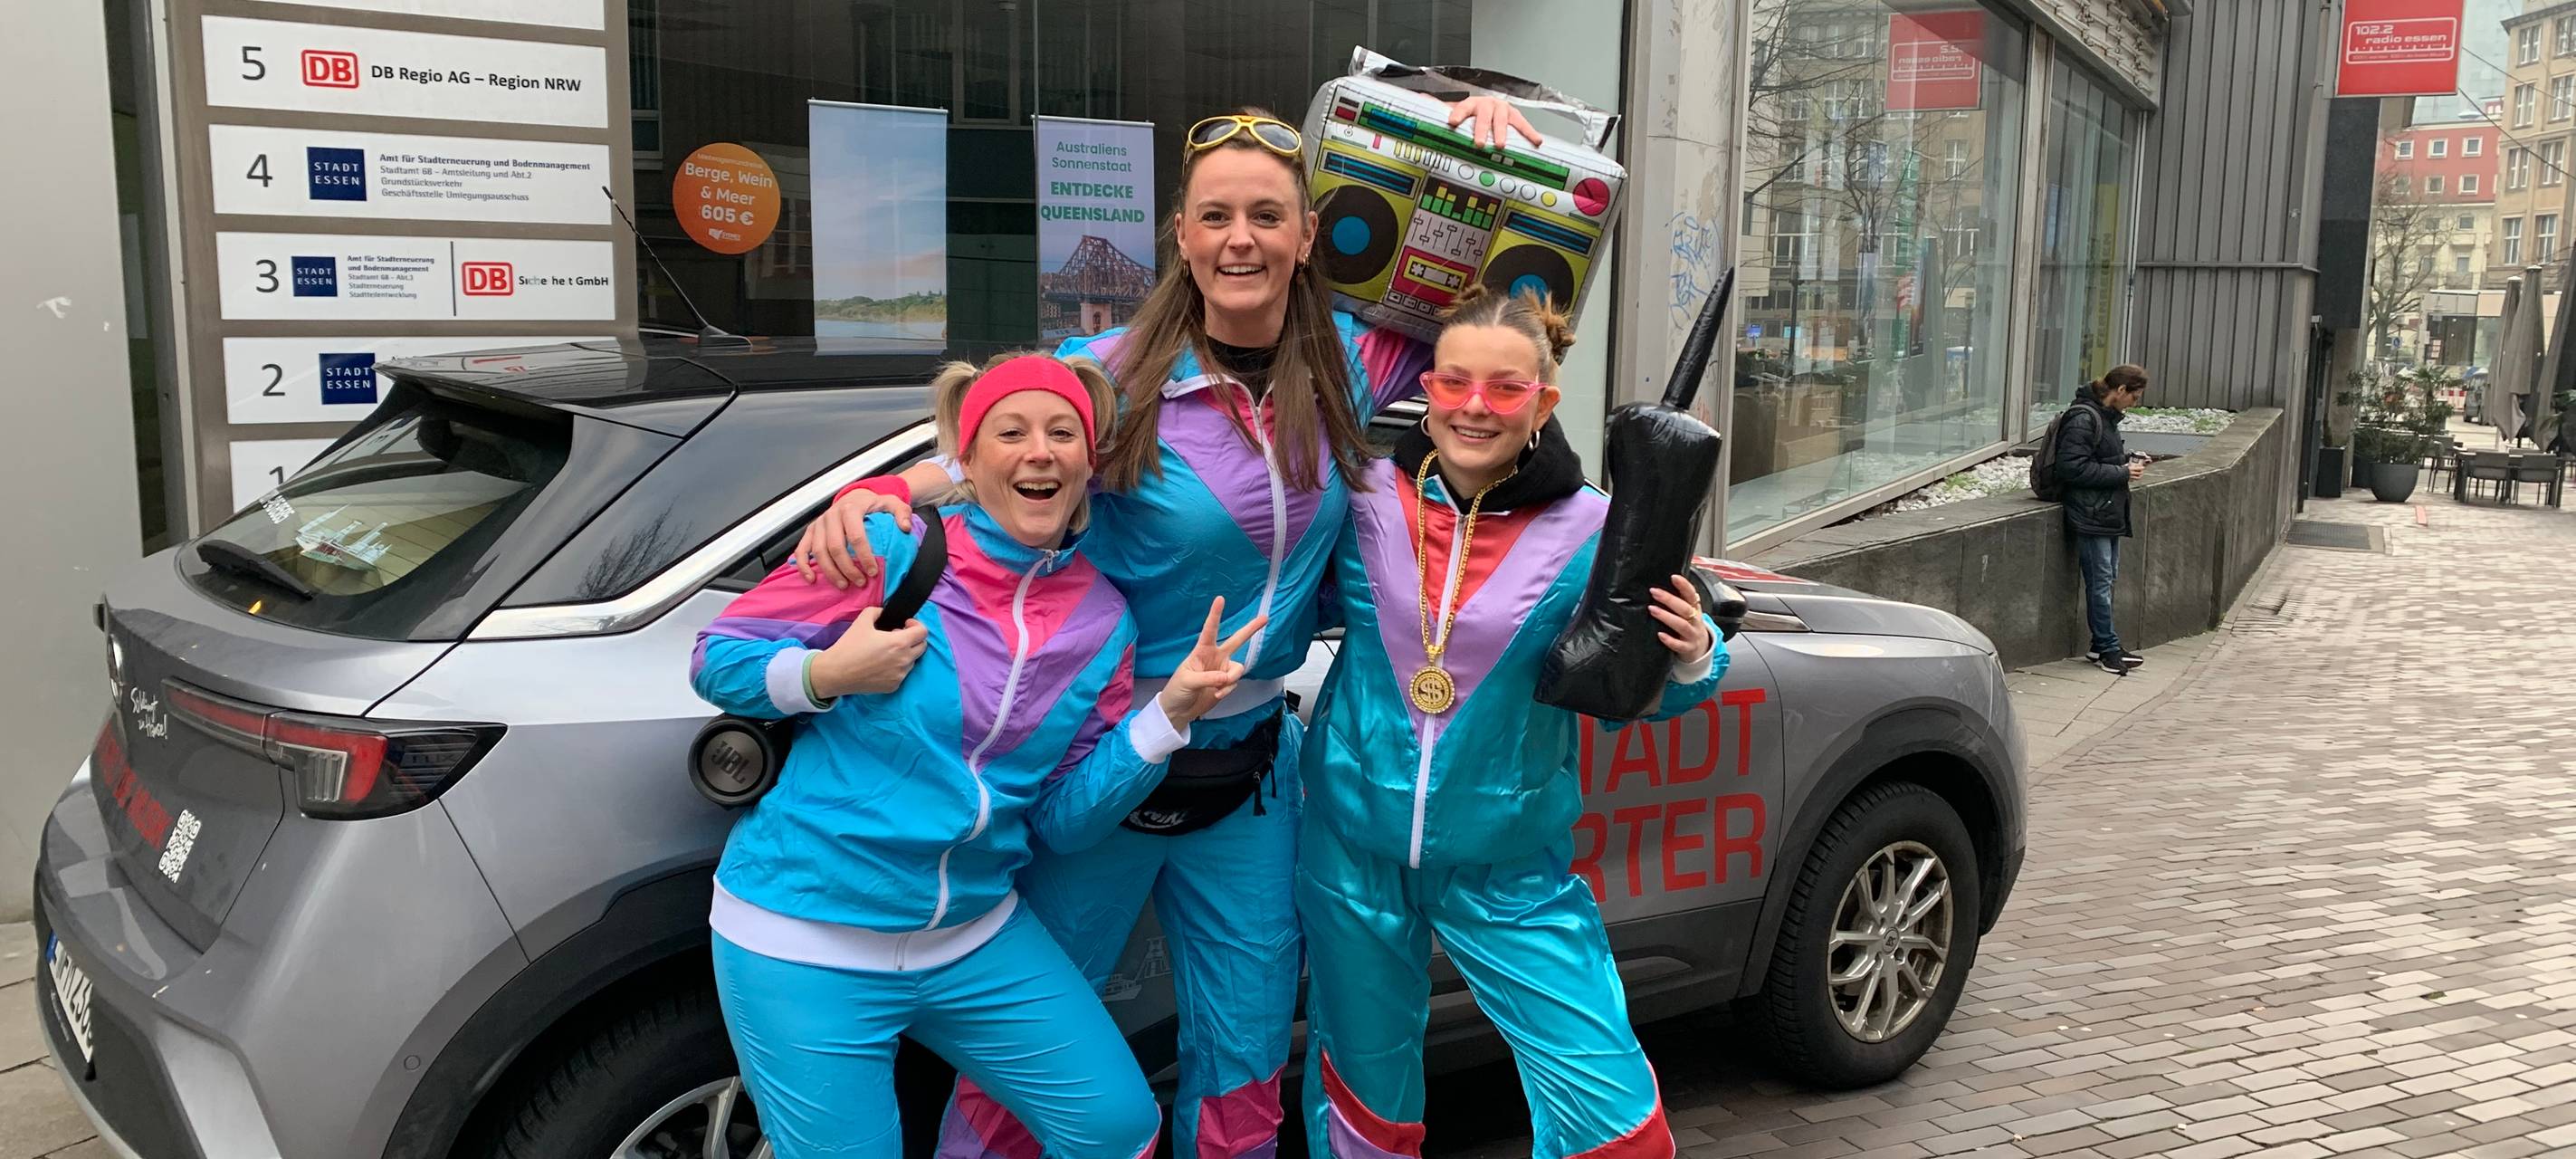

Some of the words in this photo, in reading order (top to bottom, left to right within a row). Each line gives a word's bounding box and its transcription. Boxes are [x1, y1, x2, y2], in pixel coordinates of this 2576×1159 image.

[2355, 24, 2394, 35] 102.2
[2365, 35, 2401, 44] radio
[2404, 34, 2447, 43] essen
[241, 46, 266, 81] 5
[309, 55, 353, 83] DB
[371, 65, 394, 80] DB
[399, 67, 444, 85] Regio
[447, 70, 471, 84] AG
[489, 72, 540, 91] Region
[544, 77, 581, 92] NRW
[1056, 140, 1128, 157] Australiens
[245, 153, 273, 188] 4
[313, 161, 360, 173] STADT
[379, 154, 398, 163] Amt
[401, 154, 415, 164] für
[417, 155, 491, 168] Stadterneuerung
[493, 158, 510, 168] und
[512, 159, 591, 171] Bodenmanagement
[1052, 157, 1132, 172] Sonnenstaat
[380, 166, 420, 176] Stadtamt
[422, 167, 433, 176] 68
[442, 168, 491, 179] Amtsleitung
[493, 169, 509, 178] und
[685, 162, 733, 183] Berge,
[738, 169, 773, 188] Wein
[314, 175, 360, 187] ESSEN
[381, 176, 463, 188] Grundstücksverkehr
[382, 187, 444, 199] Geschäftsstelle
[445, 189, 530, 202] Umlegungsausschuss
[701, 186, 711, 199] &
[716, 187, 756, 206] Meer
[1050, 181, 1134, 198] ENTDECKE
[701, 205, 736, 224] 605
[739, 210, 754, 225] €
[1041, 205, 1146, 223] QUEENSLAND
[348, 254, 362, 263] Amt
[364, 254, 375, 263] für
[377, 255, 434, 264] Stadterneuerung
[254, 259, 281, 293] 3
[296, 267, 332, 276] STADT
[363, 264, 429, 273] Bodenmanagement
[297, 276, 333, 287] ESSEN
[468, 266, 509, 292] DB
[576, 276, 610, 287] GmbH
[261, 363, 286, 397] 2
[326, 367, 371, 377] STADT
[326, 378, 372, 389] ESSEN
[269, 465, 285, 485] 1
[711, 740, 750, 785] JBL
